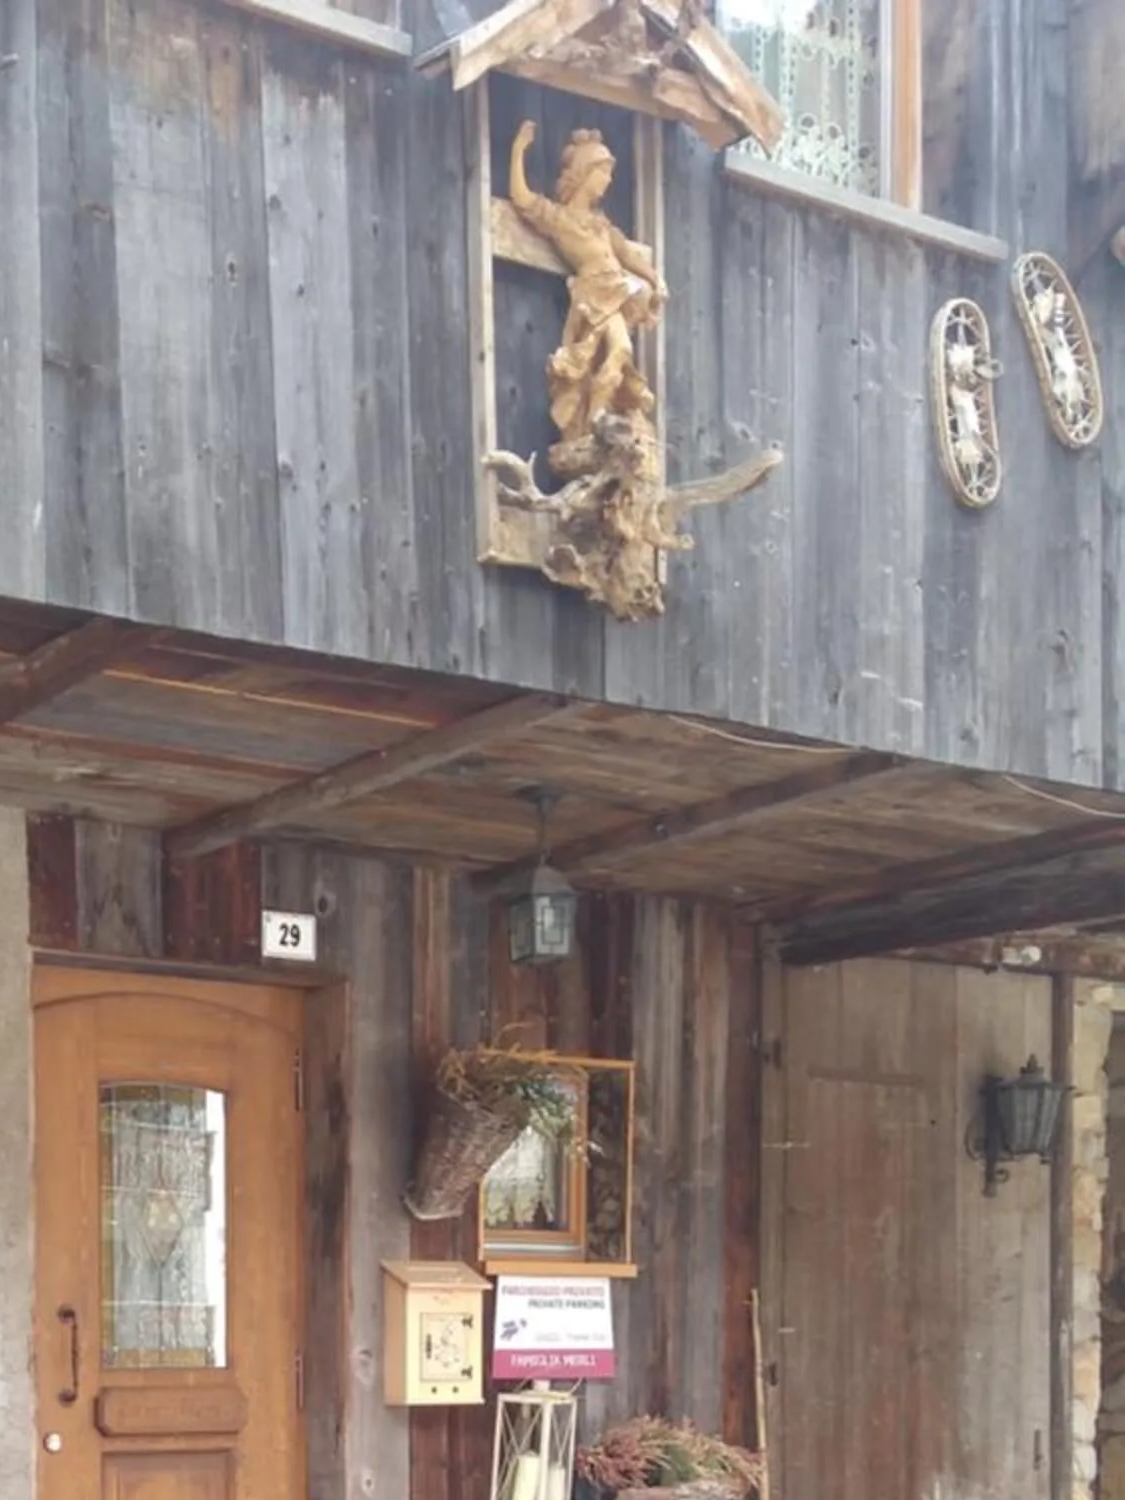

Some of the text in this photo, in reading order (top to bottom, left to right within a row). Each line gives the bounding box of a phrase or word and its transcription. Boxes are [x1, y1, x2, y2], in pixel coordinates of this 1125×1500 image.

[279, 922, 301, 947] 29
[527, 1298, 606, 1310] PRIVATE PARKING
